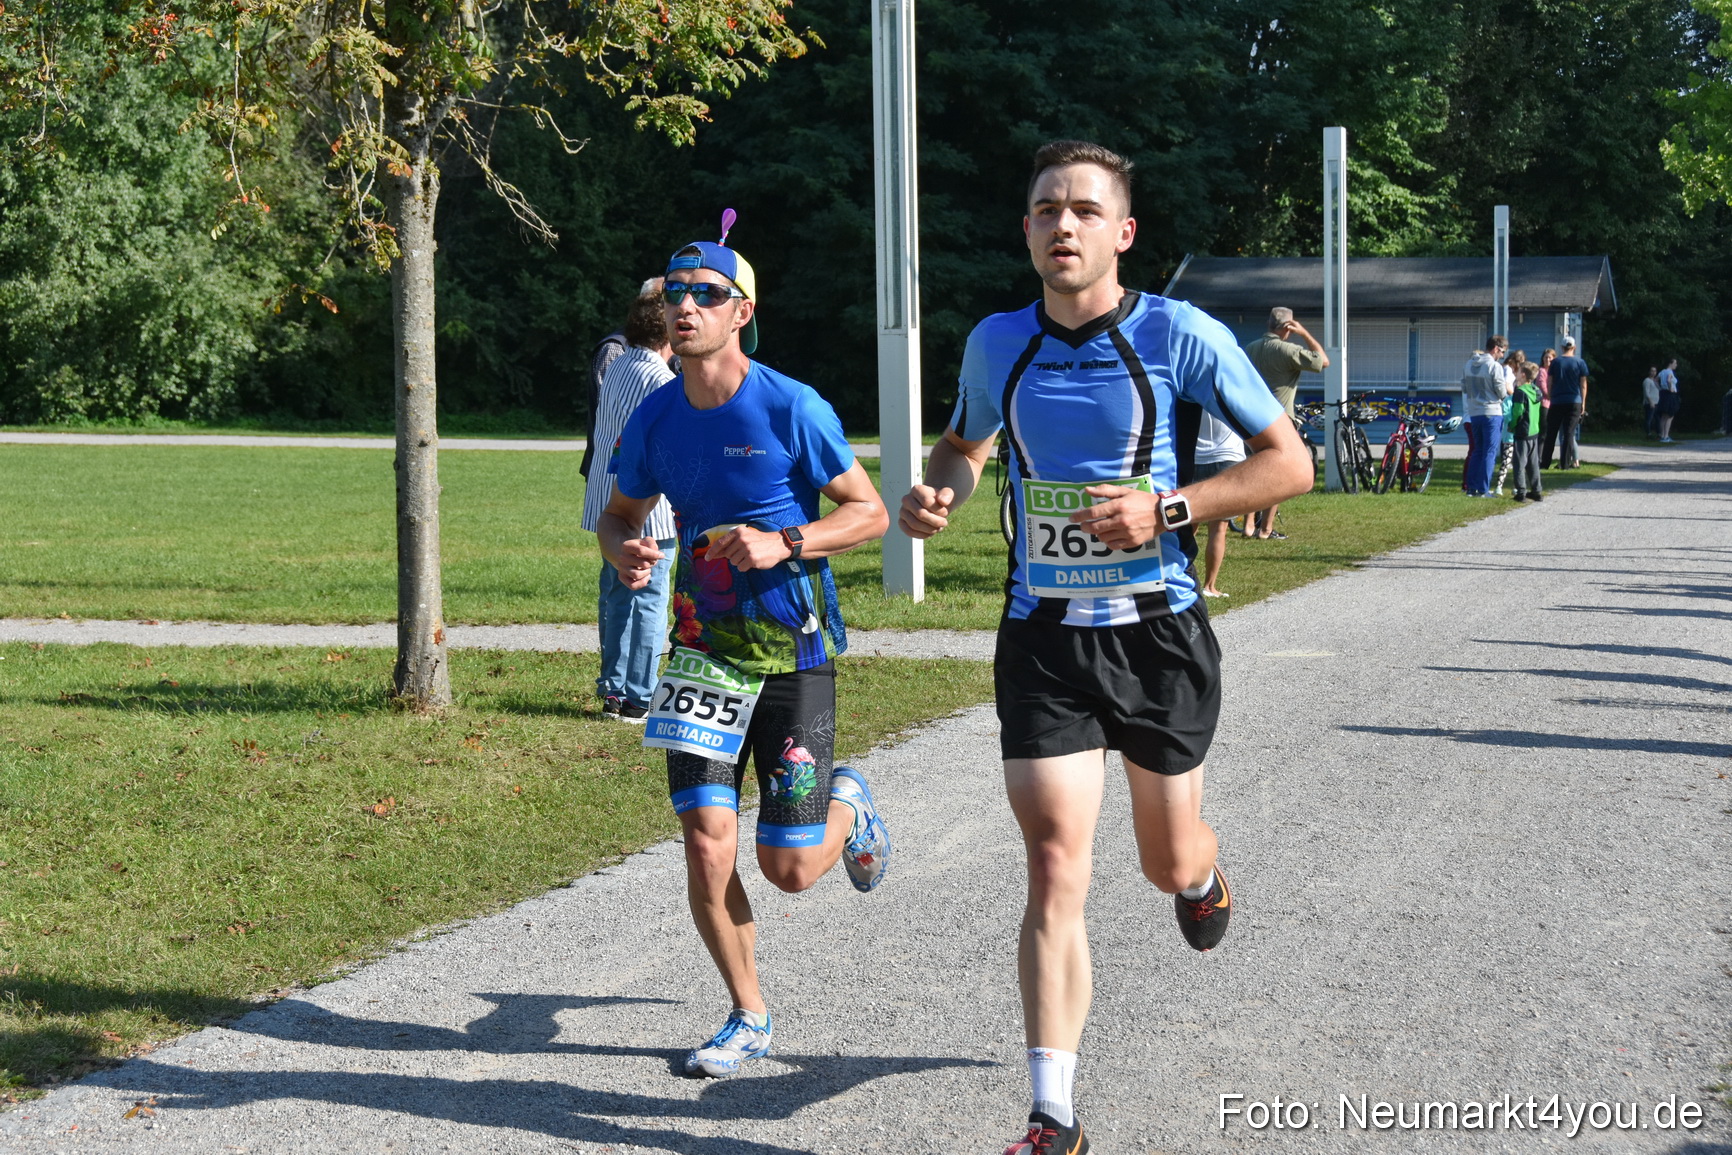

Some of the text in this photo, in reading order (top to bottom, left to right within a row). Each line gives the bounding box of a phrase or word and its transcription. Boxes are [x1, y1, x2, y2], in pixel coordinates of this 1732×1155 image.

[1031, 484, 1139, 513] BOC
[1039, 523, 1143, 558] 265
[1055, 568, 1131, 585] DANIEL
[666, 652, 752, 691] BOCK
[659, 682, 743, 726] 2655
[656, 722, 724, 748] RICHARD
